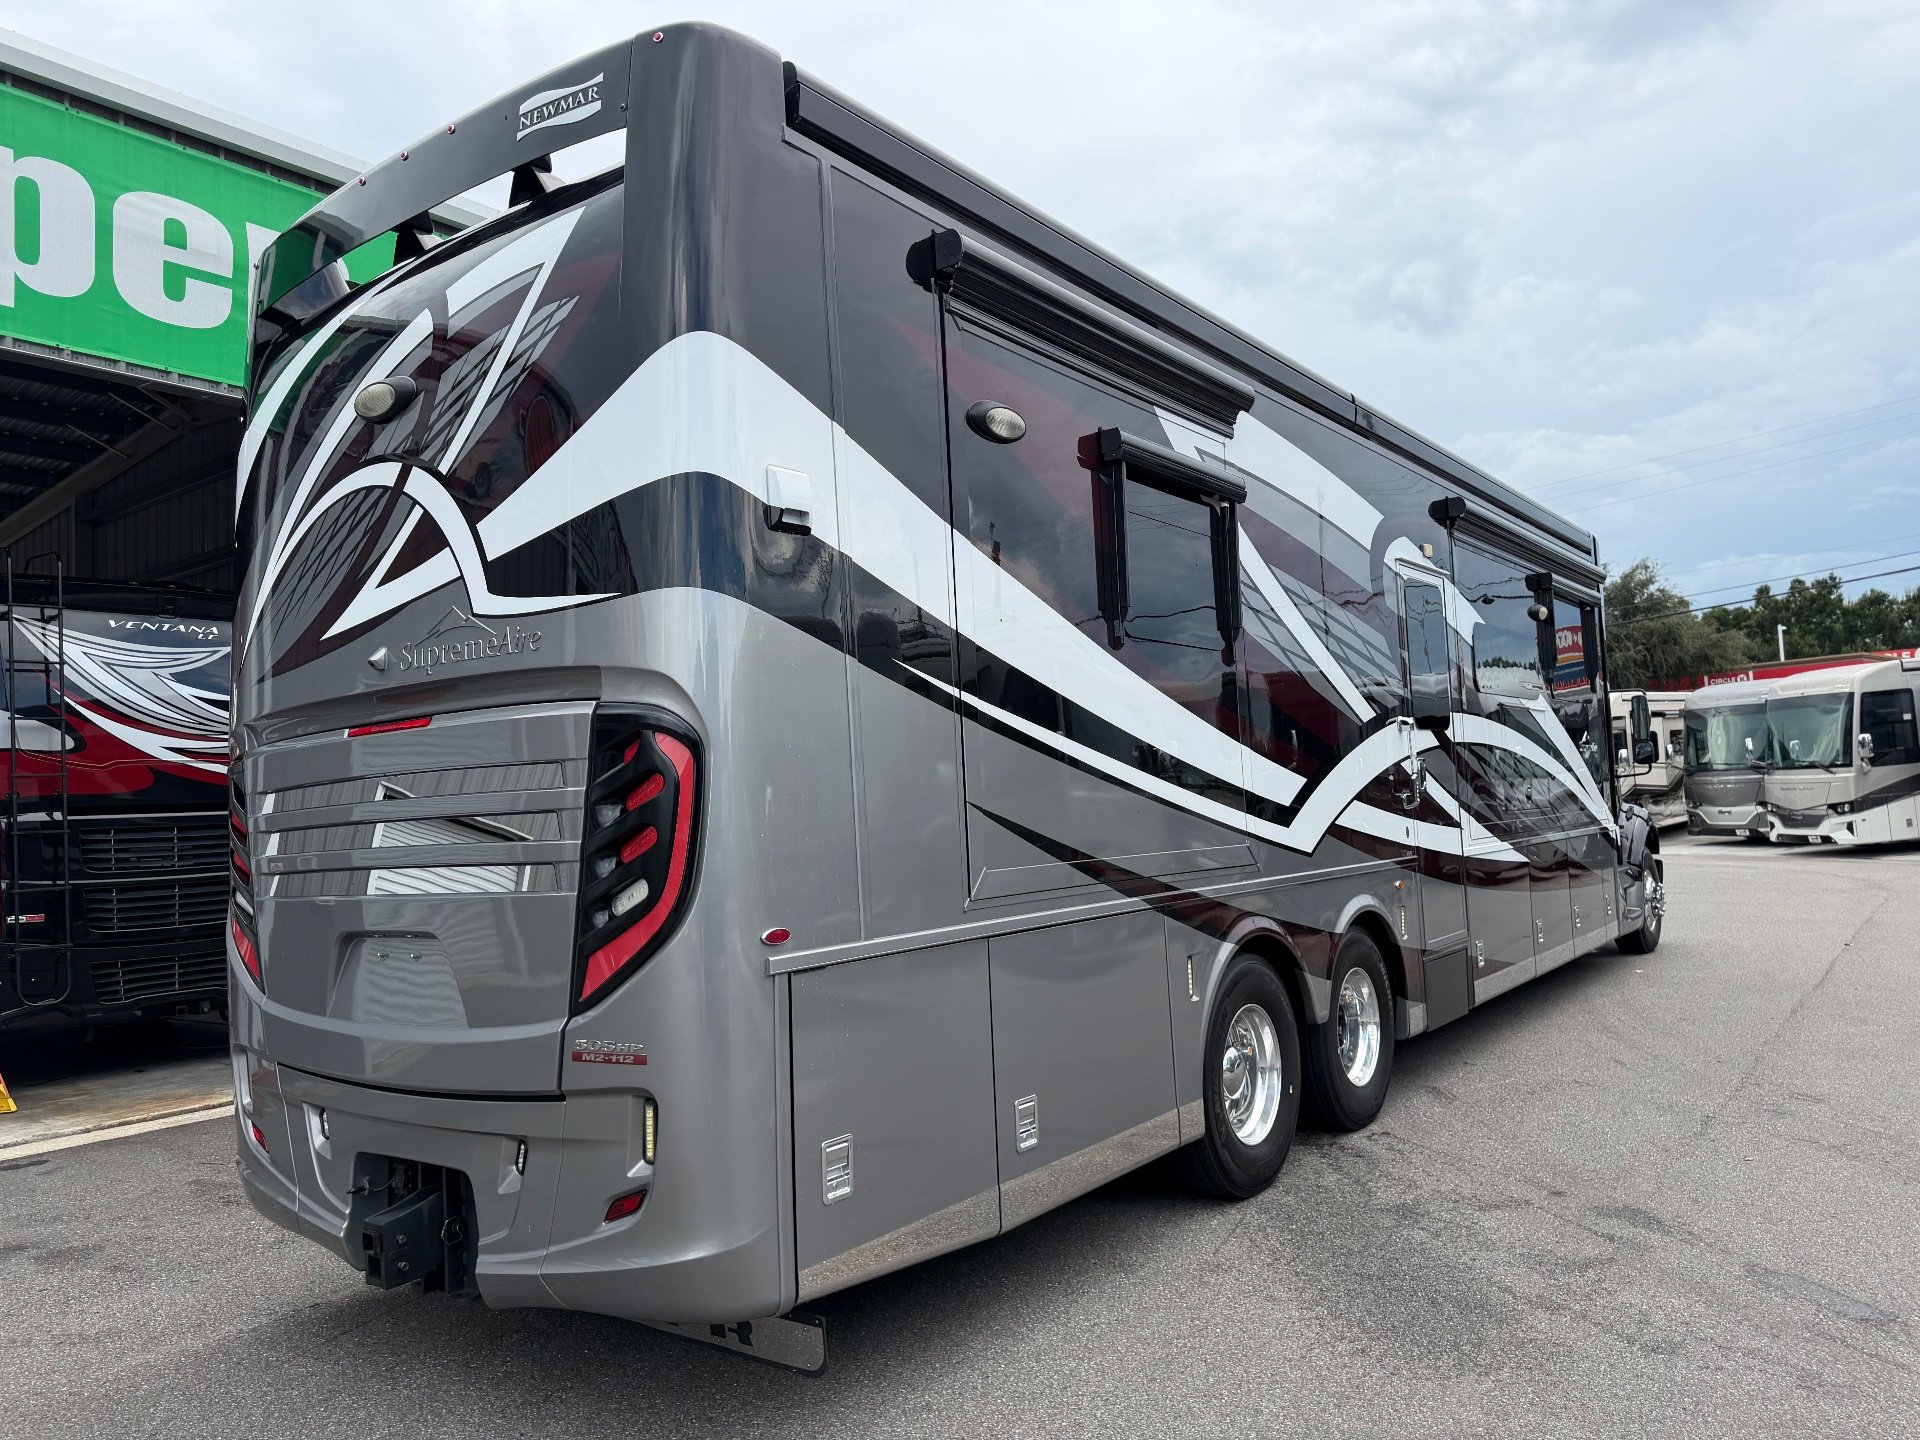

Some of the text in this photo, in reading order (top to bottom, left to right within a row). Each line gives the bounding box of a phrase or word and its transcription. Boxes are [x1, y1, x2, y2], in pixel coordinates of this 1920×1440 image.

[519, 86, 601, 130] NEWMAR
[108, 619, 219, 635] VENTANA
[400, 626, 542, 675] SupremeAire
[1710, 676, 1736, 685] CIRCLE
[575, 1039, 644, 1053] 505HP
